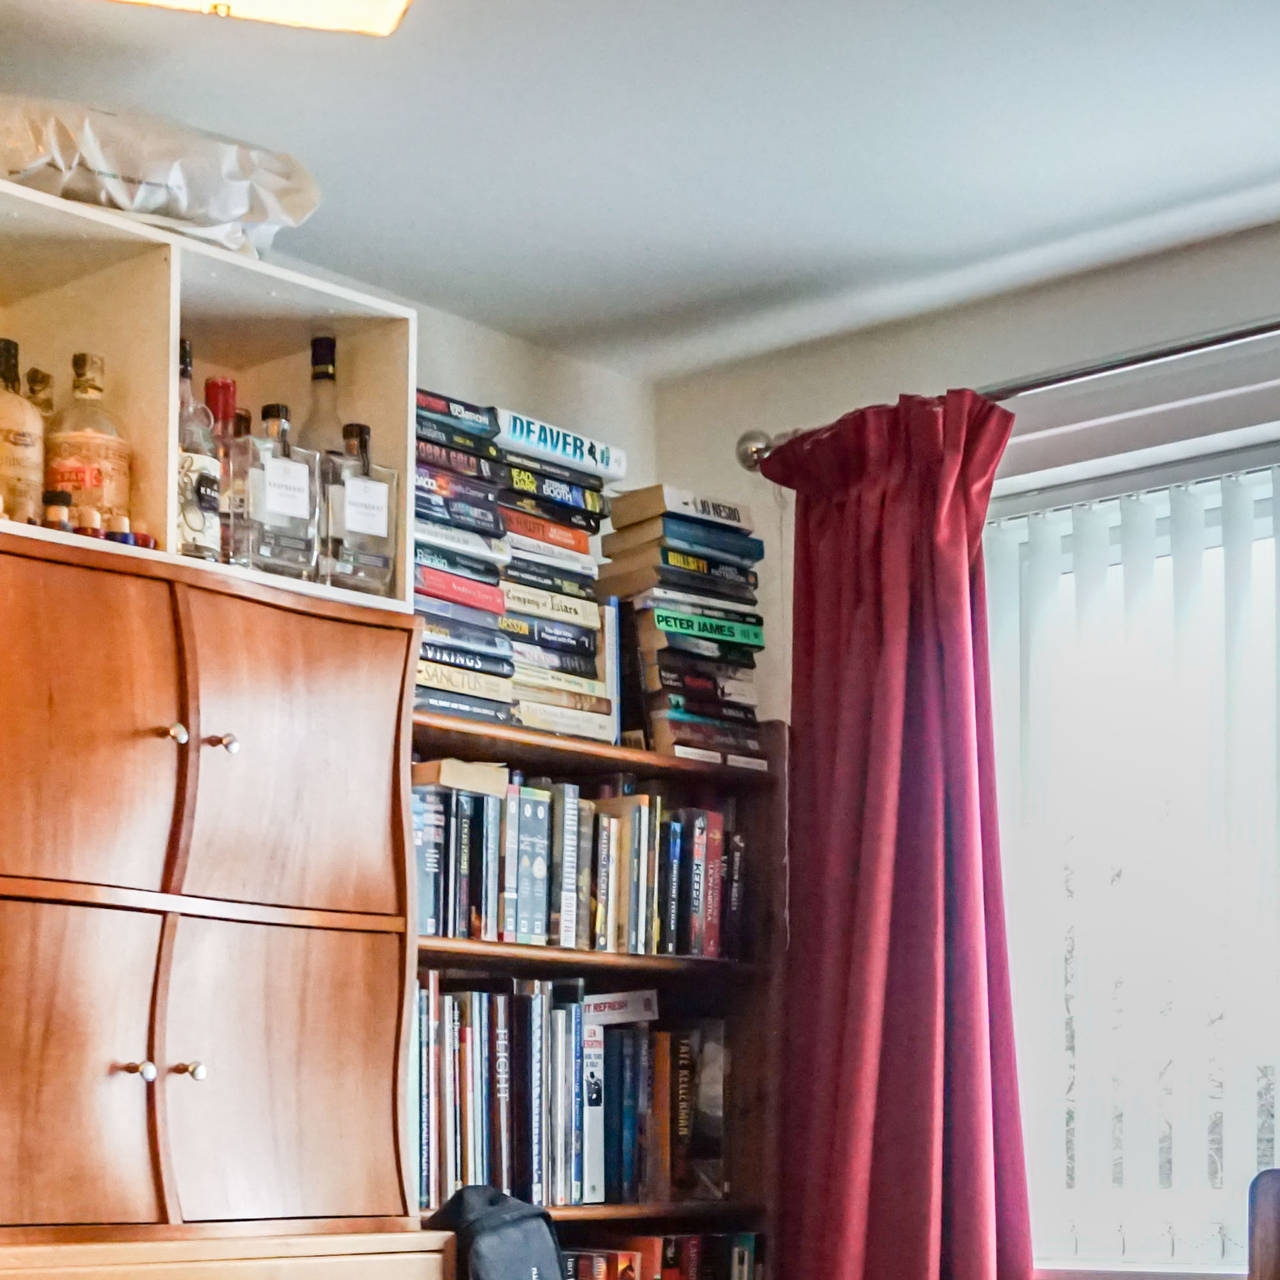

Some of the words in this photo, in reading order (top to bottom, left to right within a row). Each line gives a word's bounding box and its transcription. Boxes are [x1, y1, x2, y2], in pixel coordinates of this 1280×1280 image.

[511, 414, 586, 463] DEAVER
[512, 476, 538, 494] DARK
[542, 483, 573, 502] BOOTH
[700, 499, 711, 515] JO
[549, 594, 579, 617] Liars
[656, 613, 695, 630] PETER
[697, 621, 735, 638] JAMES
[427, 646, 483, 669] VIKINGS
[495, 1027, 509, 1102] FLIGHT
[678, 1069, 689, 1136] KELLERMAN
[567, 1258, 575, 1275] Ian
